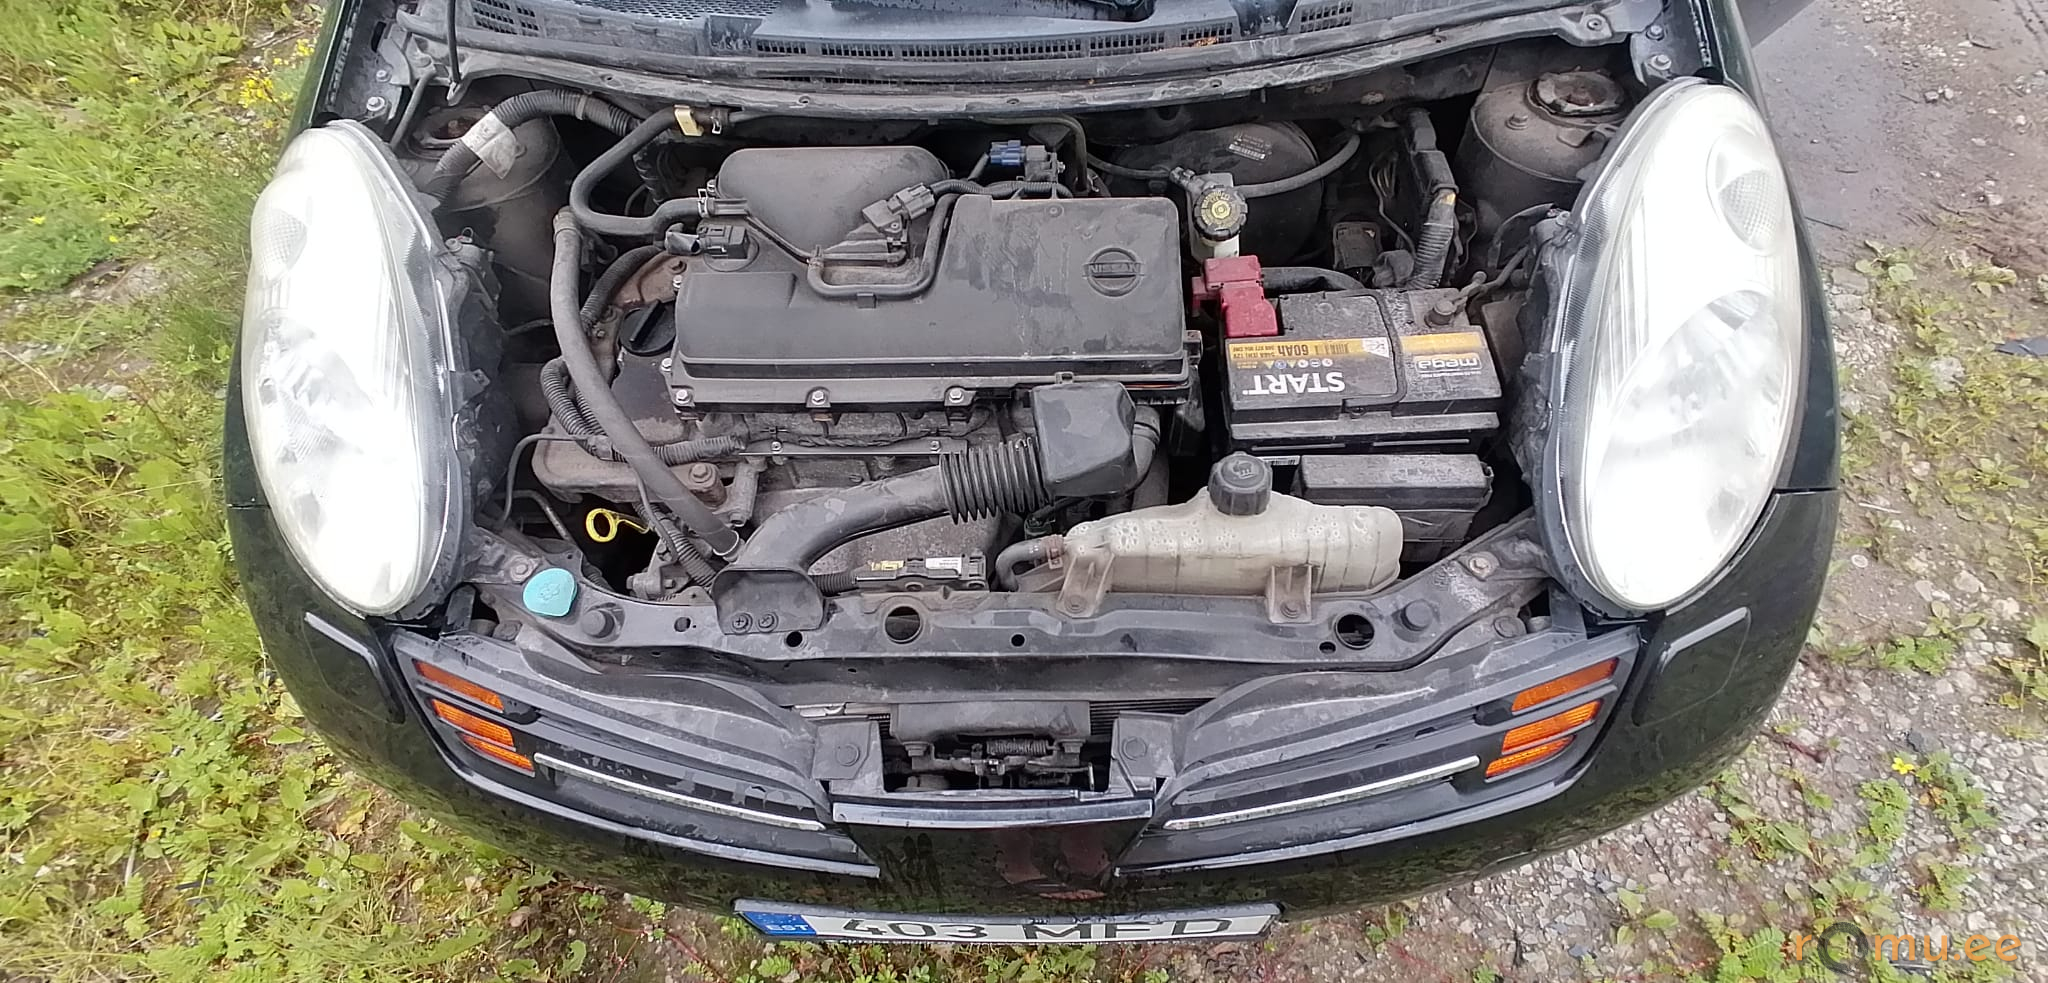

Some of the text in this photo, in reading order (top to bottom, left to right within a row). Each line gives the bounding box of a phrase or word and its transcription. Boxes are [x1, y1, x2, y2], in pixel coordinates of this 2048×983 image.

[1088, 263, 1141, 274] NISSAN
[1277, 344, 1309, 357] 60Ah
[1418, 357, 1478, 369] mega
[1248, 371, 1346, 395] START
[843, 918, 1233, 940] 403 MFD
